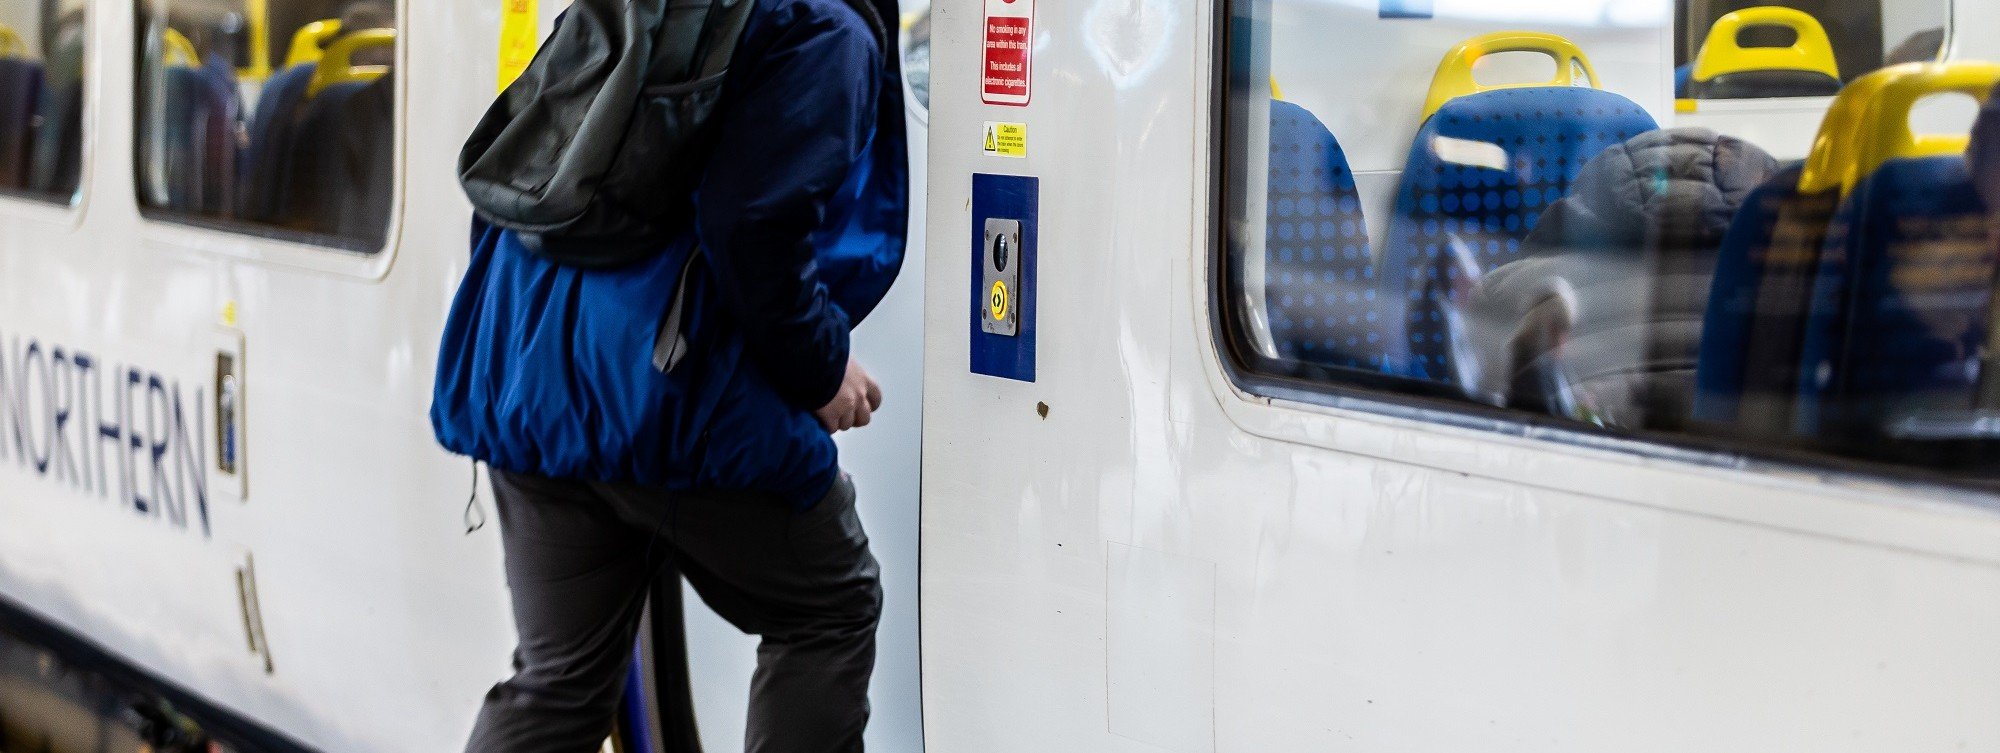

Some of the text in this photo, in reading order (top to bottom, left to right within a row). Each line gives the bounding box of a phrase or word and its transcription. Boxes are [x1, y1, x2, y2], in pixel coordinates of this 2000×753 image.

[990, 24, 995, 33] No
[996, 25, 1013, 36] smoking
[1018, 27, 1027, 36] any
[996, 39, 1008, 49] within
[990, 61, 998, 70] This
[999, 62, 1016, 71] includes
[985, 76, 1004, 86] electronic
[1003, 125, 1017, 133] Caution
[0, 333, 212, 541] NORTHERN
